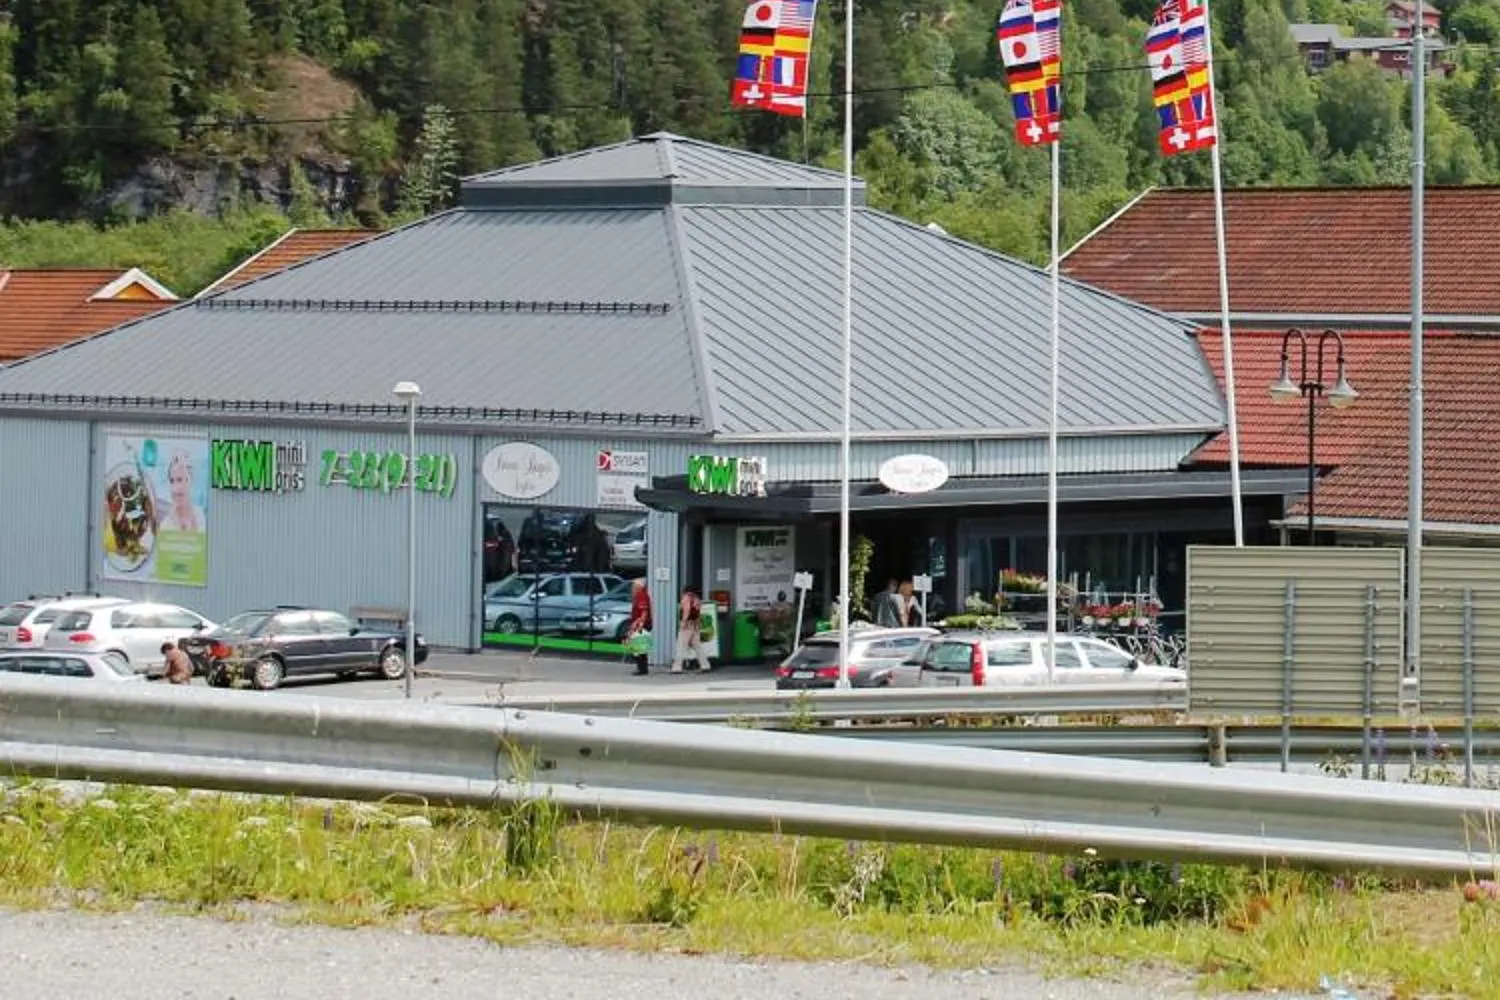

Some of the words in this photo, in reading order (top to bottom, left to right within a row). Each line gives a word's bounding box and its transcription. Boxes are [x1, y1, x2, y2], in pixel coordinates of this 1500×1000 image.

[212, 439, 276, 491] KIWI
[276, 440, 306, 465] mini
[688, 455, 740, 496] KIWI
